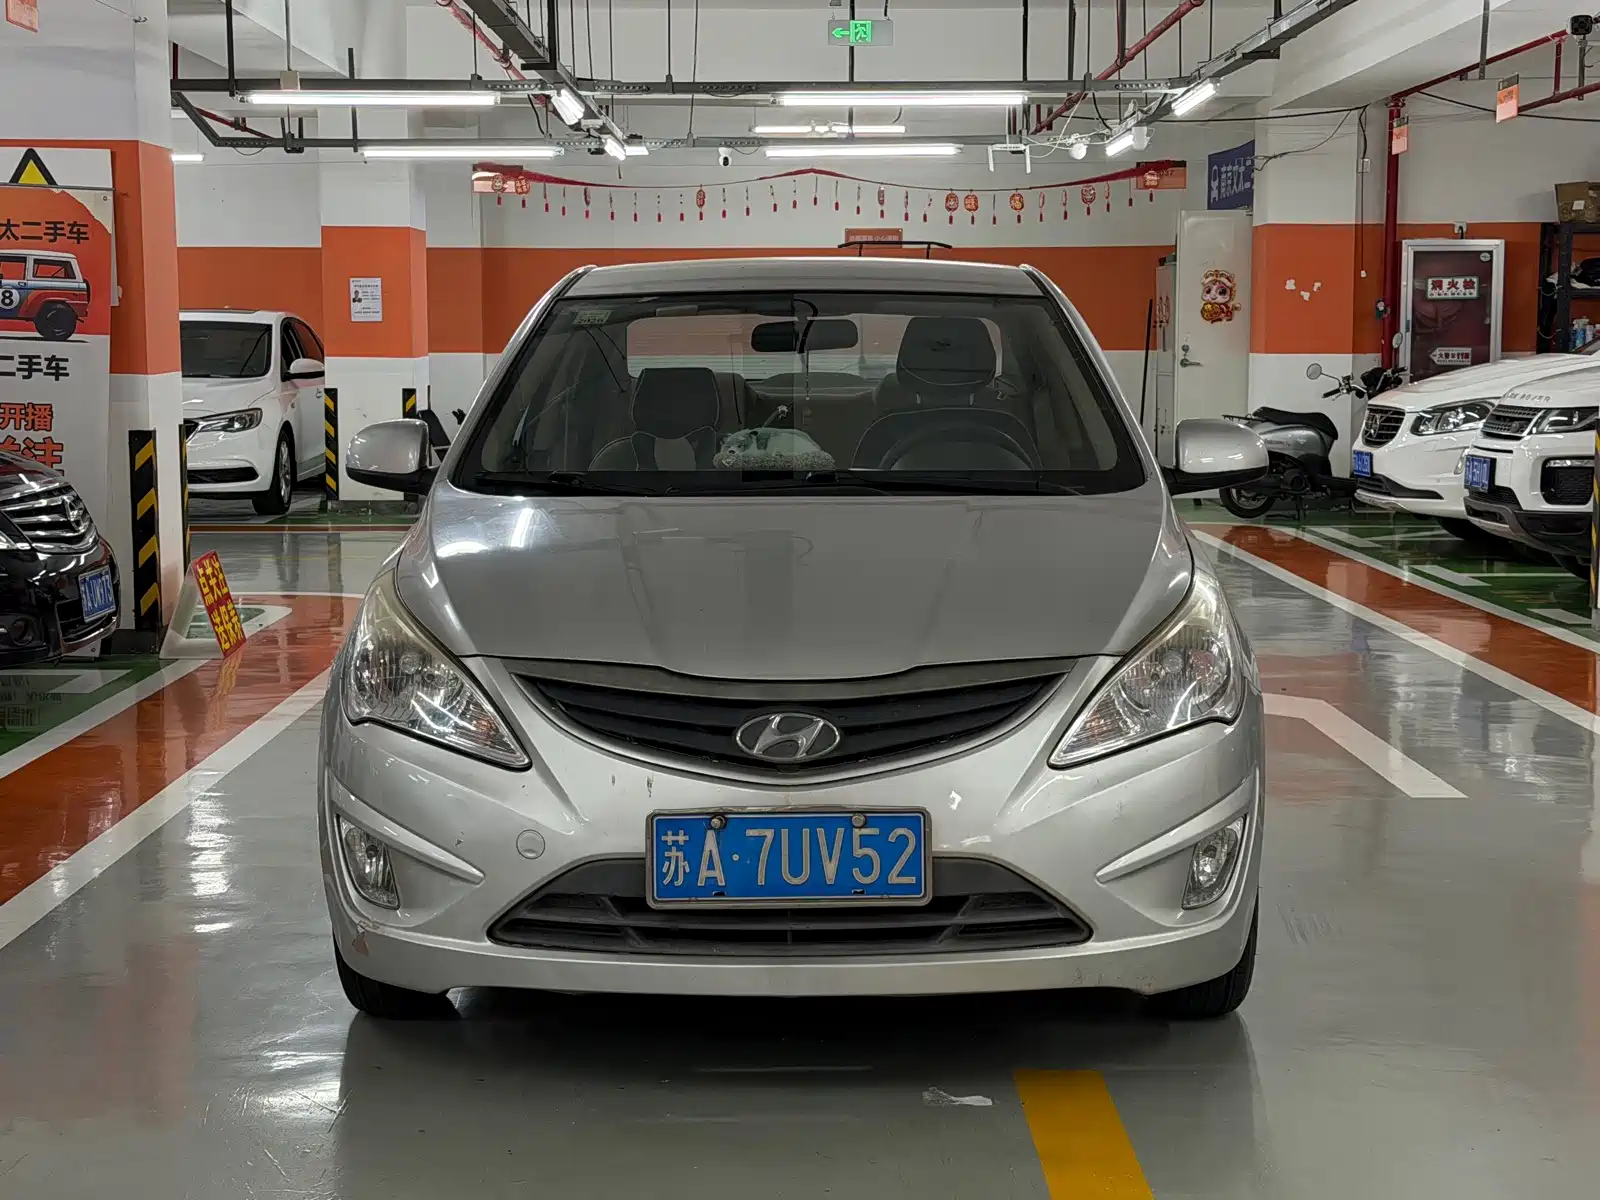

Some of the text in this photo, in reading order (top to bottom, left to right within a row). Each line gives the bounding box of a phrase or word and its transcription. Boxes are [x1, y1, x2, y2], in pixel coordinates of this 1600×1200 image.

[0, 218, 90, 244] 太二手车
[0, 354, 70, 381] 二手车
[0, 402, 53, 431] 开播
[661, 828, 916, 887] 苏A·7UV52
